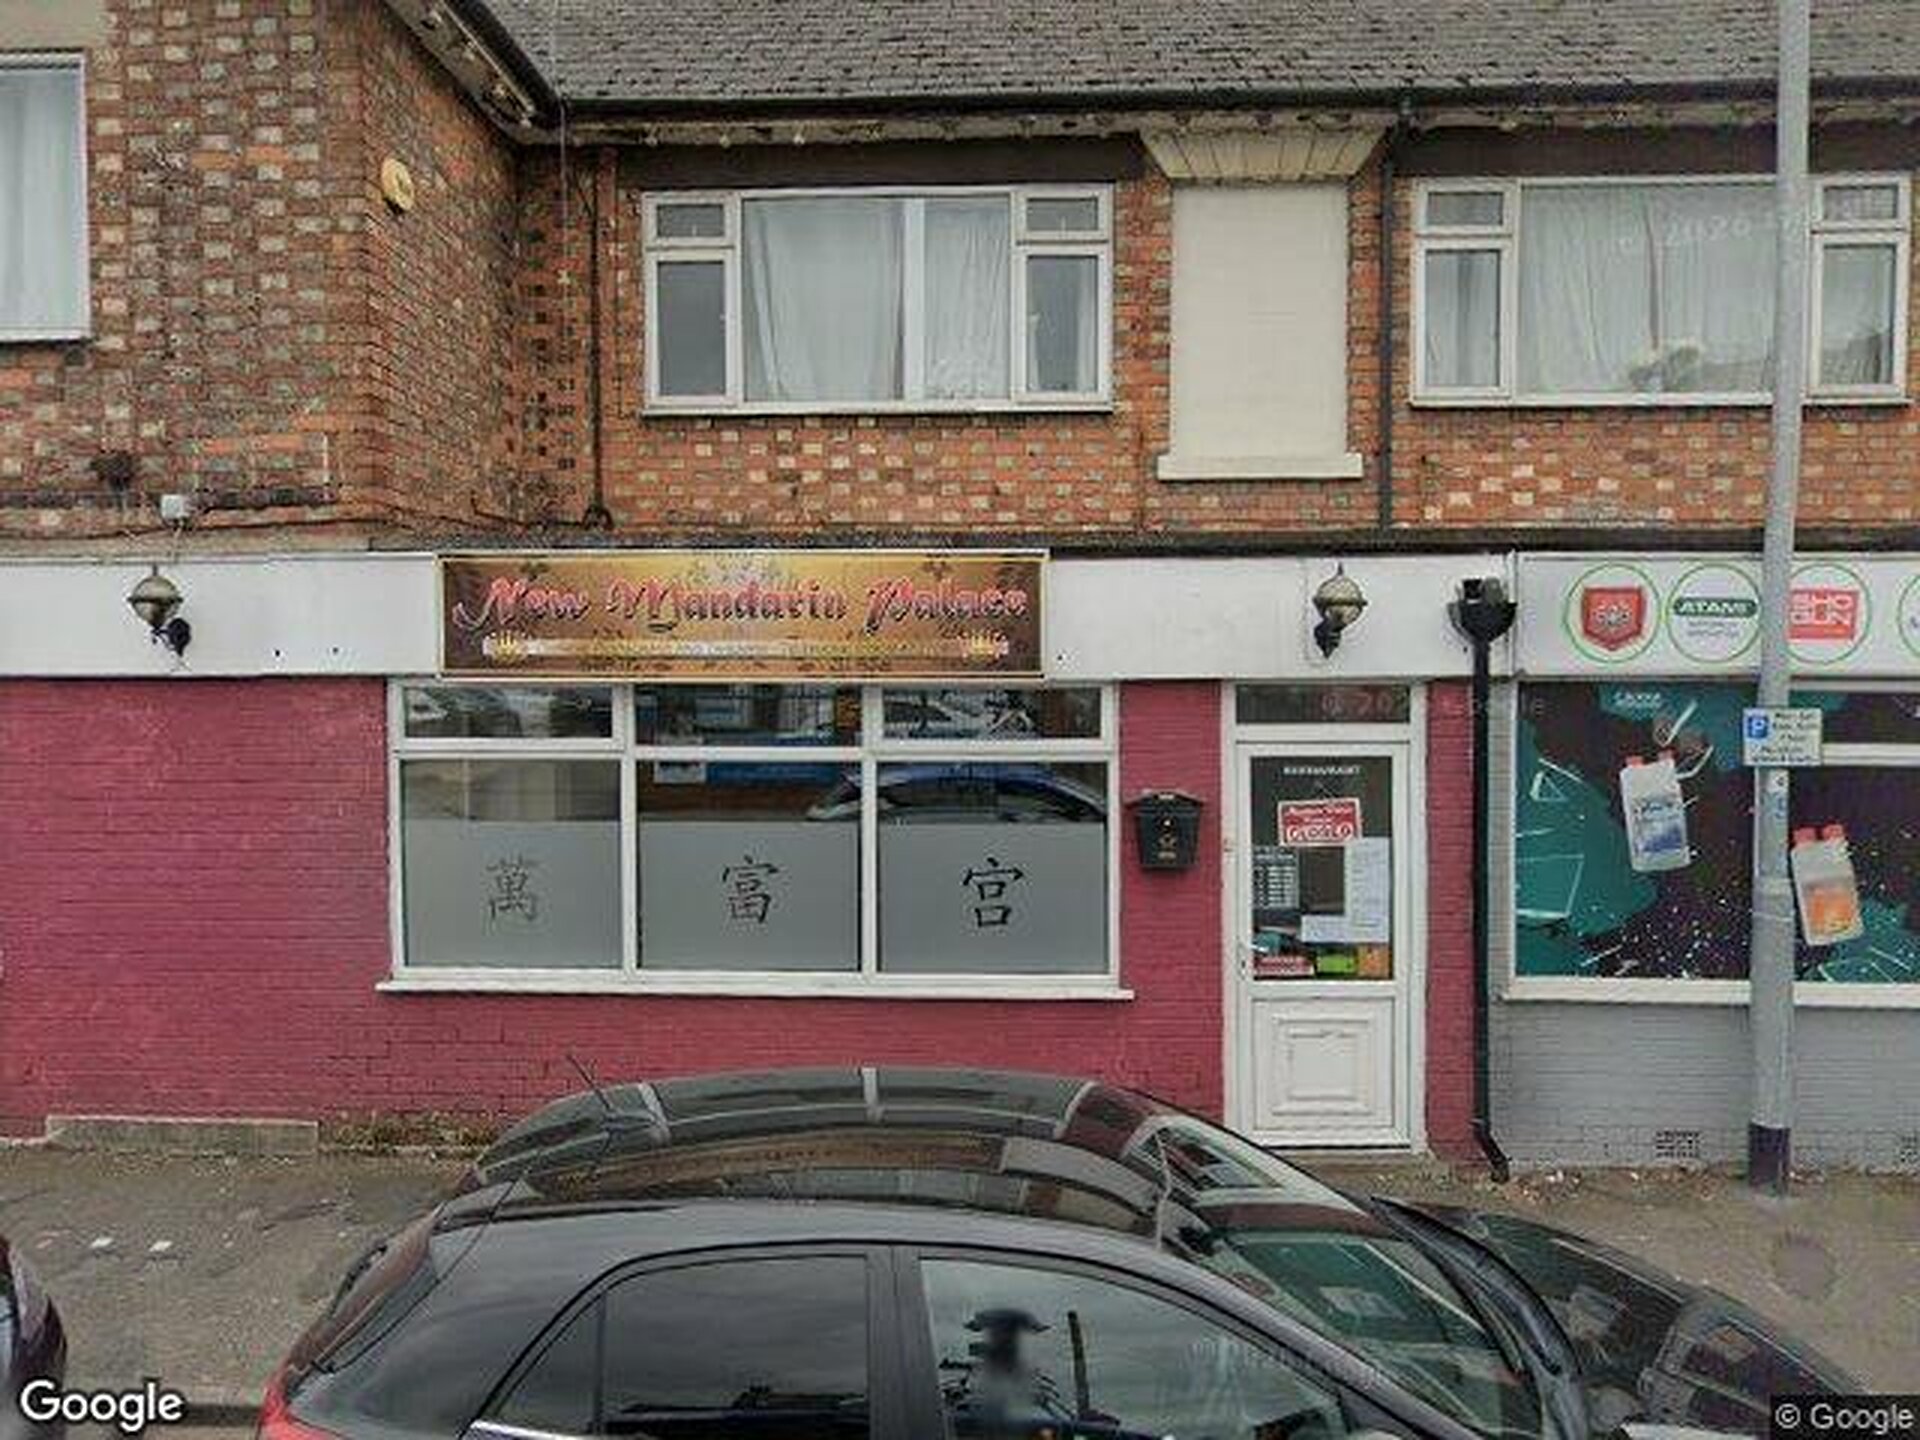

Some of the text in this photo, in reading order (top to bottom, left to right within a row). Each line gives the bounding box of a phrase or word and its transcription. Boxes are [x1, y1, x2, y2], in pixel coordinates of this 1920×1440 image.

[453, 576, 1028, 635] New Mandarin Palace
